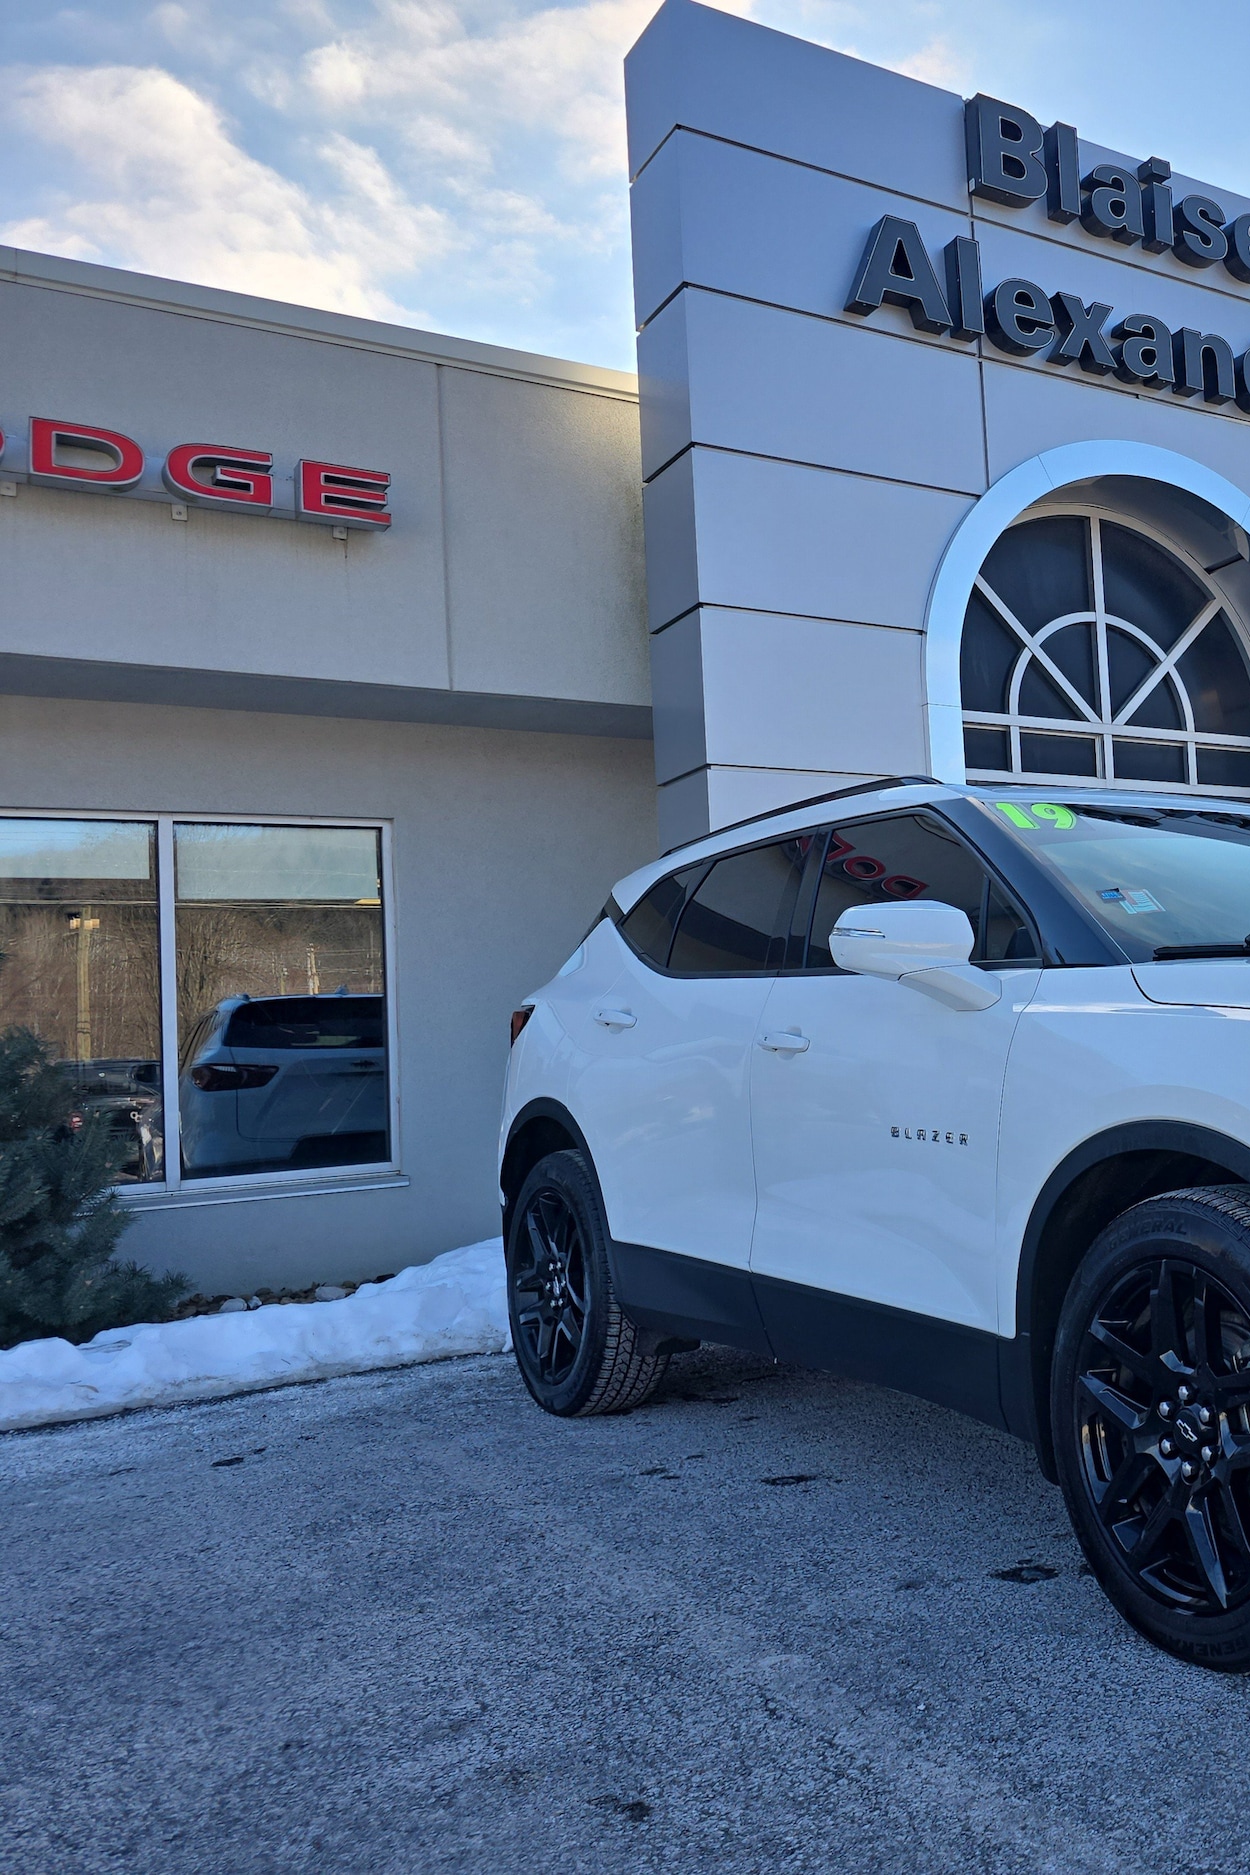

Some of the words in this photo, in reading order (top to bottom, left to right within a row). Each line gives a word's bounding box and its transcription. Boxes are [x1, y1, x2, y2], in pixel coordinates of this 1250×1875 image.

[0, 416, 391, 531] DGE
[995, 802, 1077, 830] 19
[890, 1126, 969, 1146] BLAZER
[1107, 1218, 1188, 1251] GENERAL
